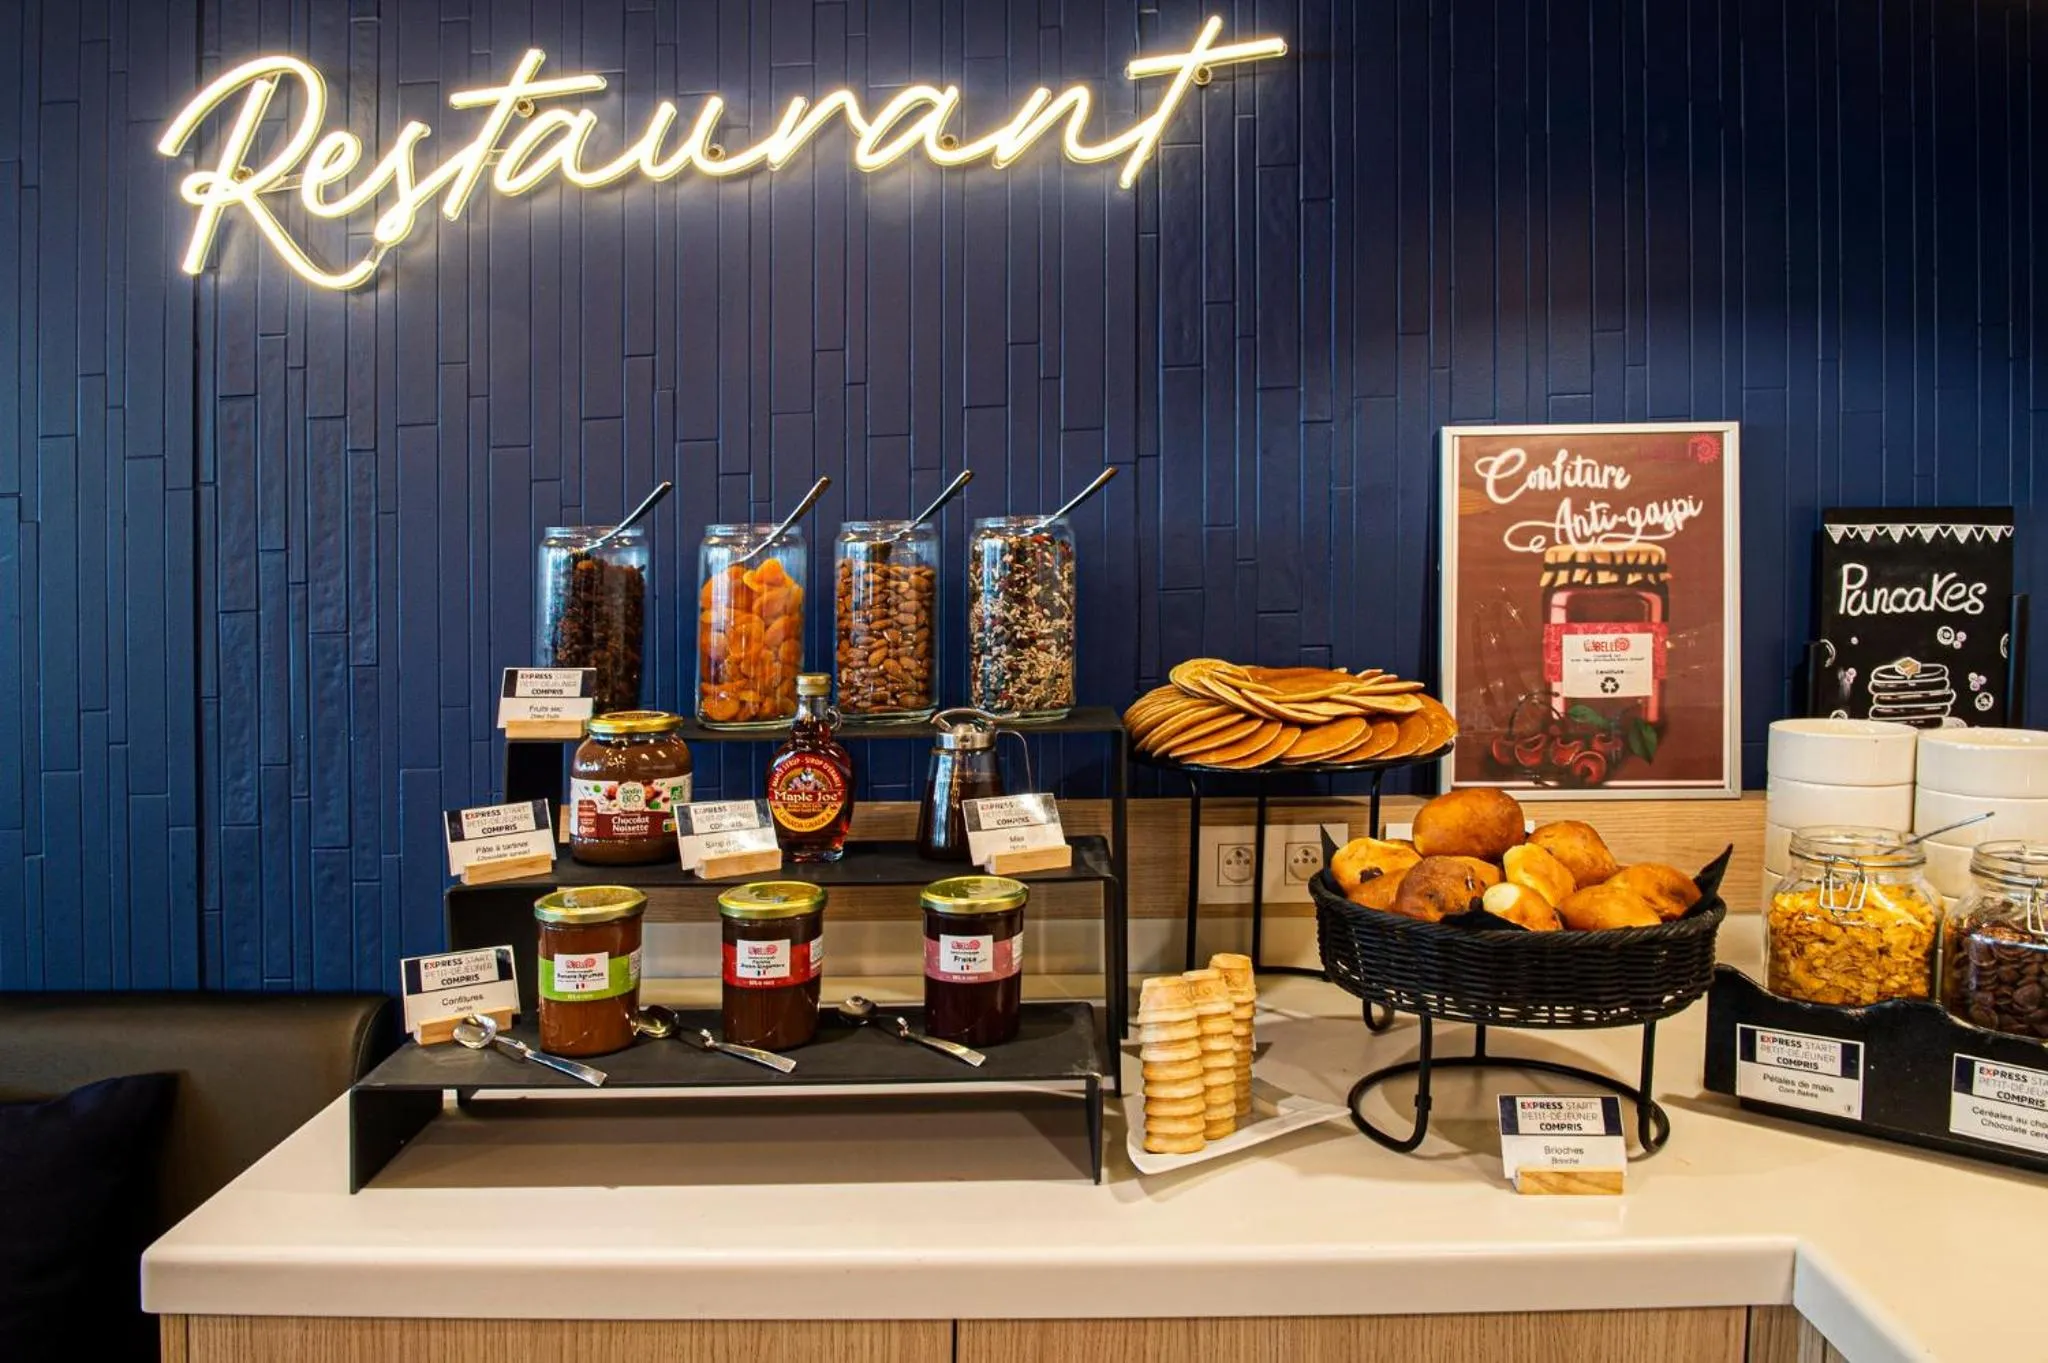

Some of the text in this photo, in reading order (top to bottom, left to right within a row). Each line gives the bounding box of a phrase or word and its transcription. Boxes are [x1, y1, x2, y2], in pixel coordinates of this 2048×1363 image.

[157, 14, 1288, 290] Restaurant
[1474, 447, 1631, 504] Confiture
[1504, 495, 1703, 552] Anti-gaspi
[1839, 563, 1988, 616] Pancakes
[520, 672, 553, 680] EXPRESS
[773, 789, 838, 803] Maple Joe
[465, 809, 501, 820] EXPRESS
[611, 816, 649, 824] Chocolat
[481, 823, 518, 835] COMPRIS
[612, 823, 649, 833] Noisette
[424, 958, 463, 970] EXPRESS
[441, 973, 480, 986] COMPRIS
[441, 993, 484, 1006] Confitures
[1760, 1035, 1802, 1048] EXPRESS
[1776, 1056, 1819, 1070] COMPRIS
[1979, 1066, 2028, 1083] EXPRESS
[1778, 1086, 1796, 1094] Corn
[1798, 1080, 1810, 1089] de
[1996, 1090, 2046, 1108] COMPRIS
[1520, 1101, 1563, 1110] EXPRESS
[1539, 1122, 1583, 1131] COMPRIS
[1980, 1118, 2027, 1135] Chocolate
[2016, 1116, 2028, 1125] au
[1543, 1145, 1585, 1156] Brioches
